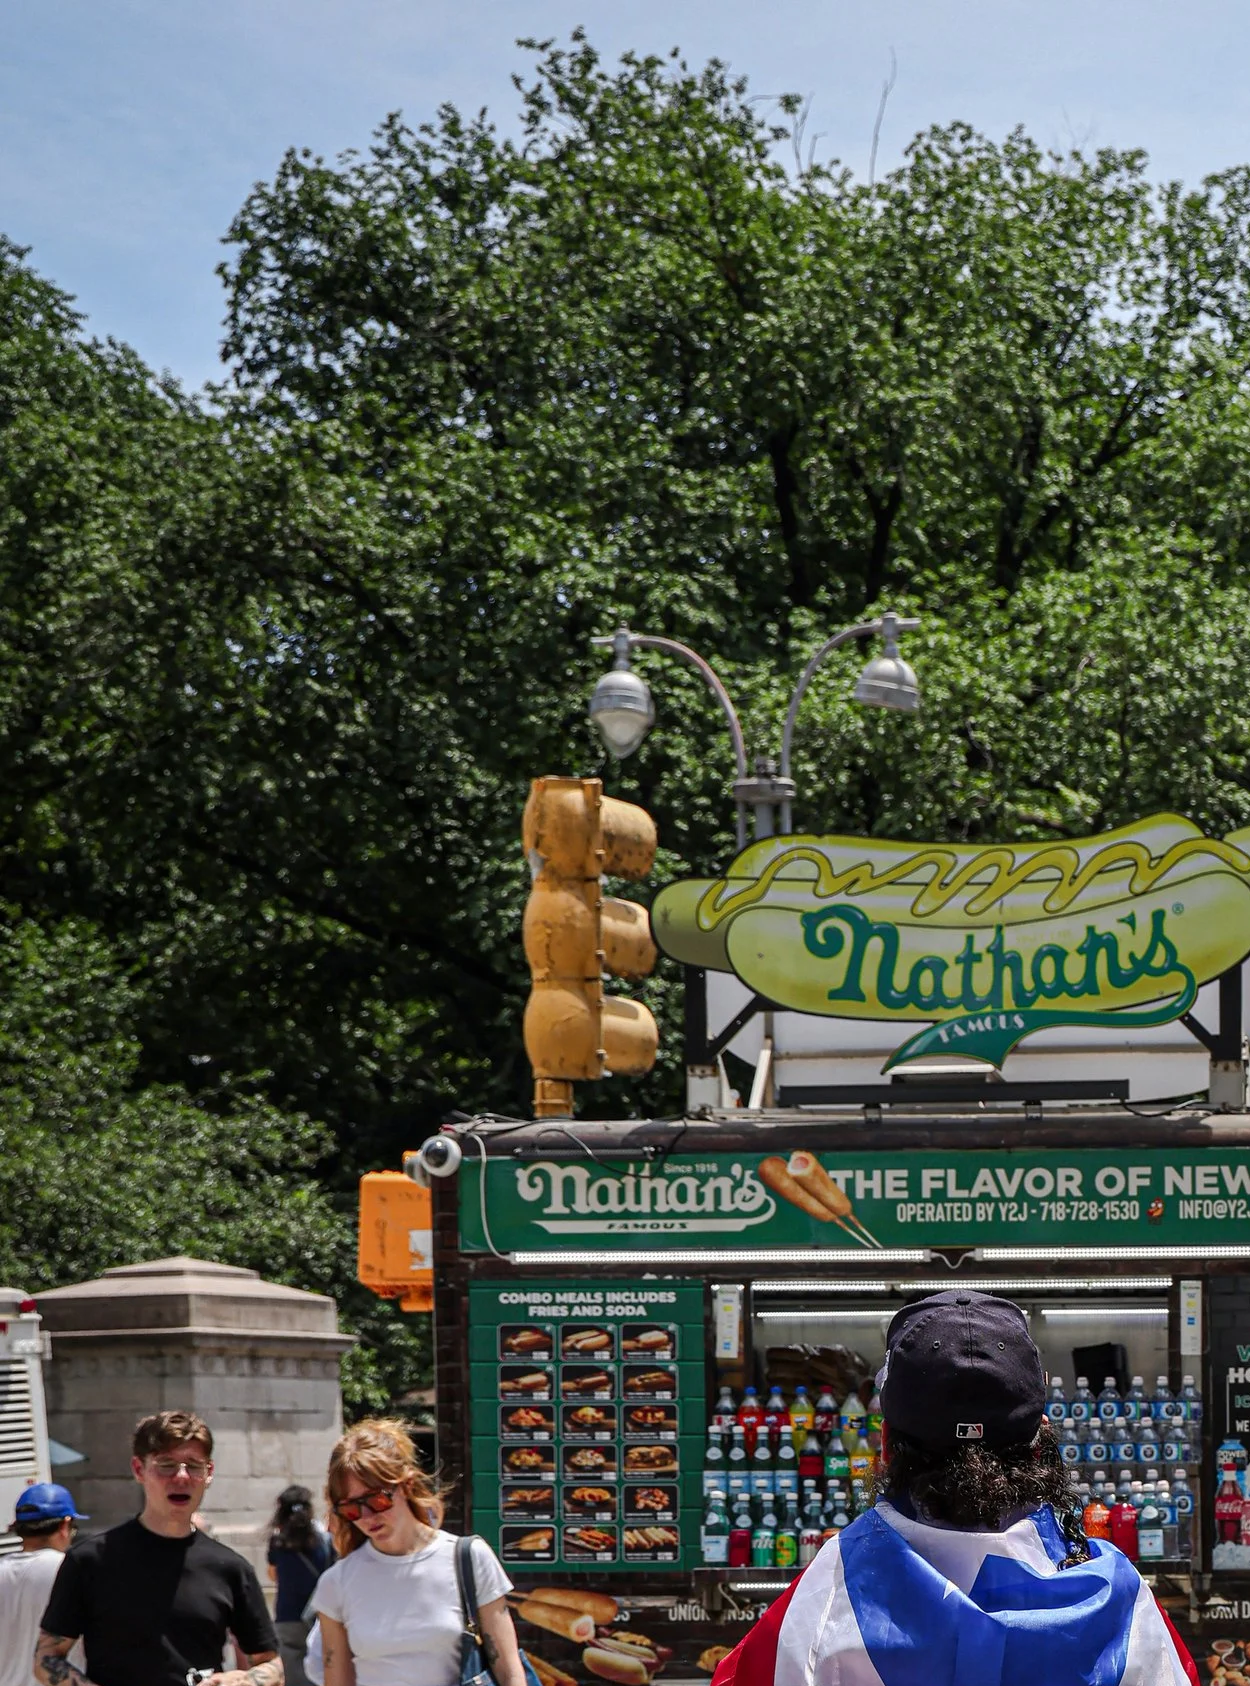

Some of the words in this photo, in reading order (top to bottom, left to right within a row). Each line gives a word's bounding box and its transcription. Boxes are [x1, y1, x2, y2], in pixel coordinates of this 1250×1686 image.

[801, 903, 1180, 1011] Nathan's
[938, 1012, 1026, 1044] FAMOUS
[663, 1164, 692, 1173] Since
[515, 1162, 767, 1214] Nathan's
[829, 1169, 909, 1199] THE
[921, 1167, 1082, 1199] FLAVOR
[1094, 1166, 1152, 1196] OF
[897, 1202, 972, 1222] OPERATED
[976, 1202, 994, 1221] BY
[1000, 1201, 1028, 1222] Y2J
[1040, 1200, 1139, 1221] 718-728-1530
[606, 1222, 689, 1230] FAMOUS
[498, 1292, 553, 1304] COMBO
[556, 1292, 603, 1303] MEALS
[606, 1291, 676, 1303] INCLUDES
[528, 1305, 568, 1316] FRIES
[571, 1305, 600, 1316] AND
[606, 1304, 647, 1316] SODA
[1236, 1420, 1250, 1432] WE
